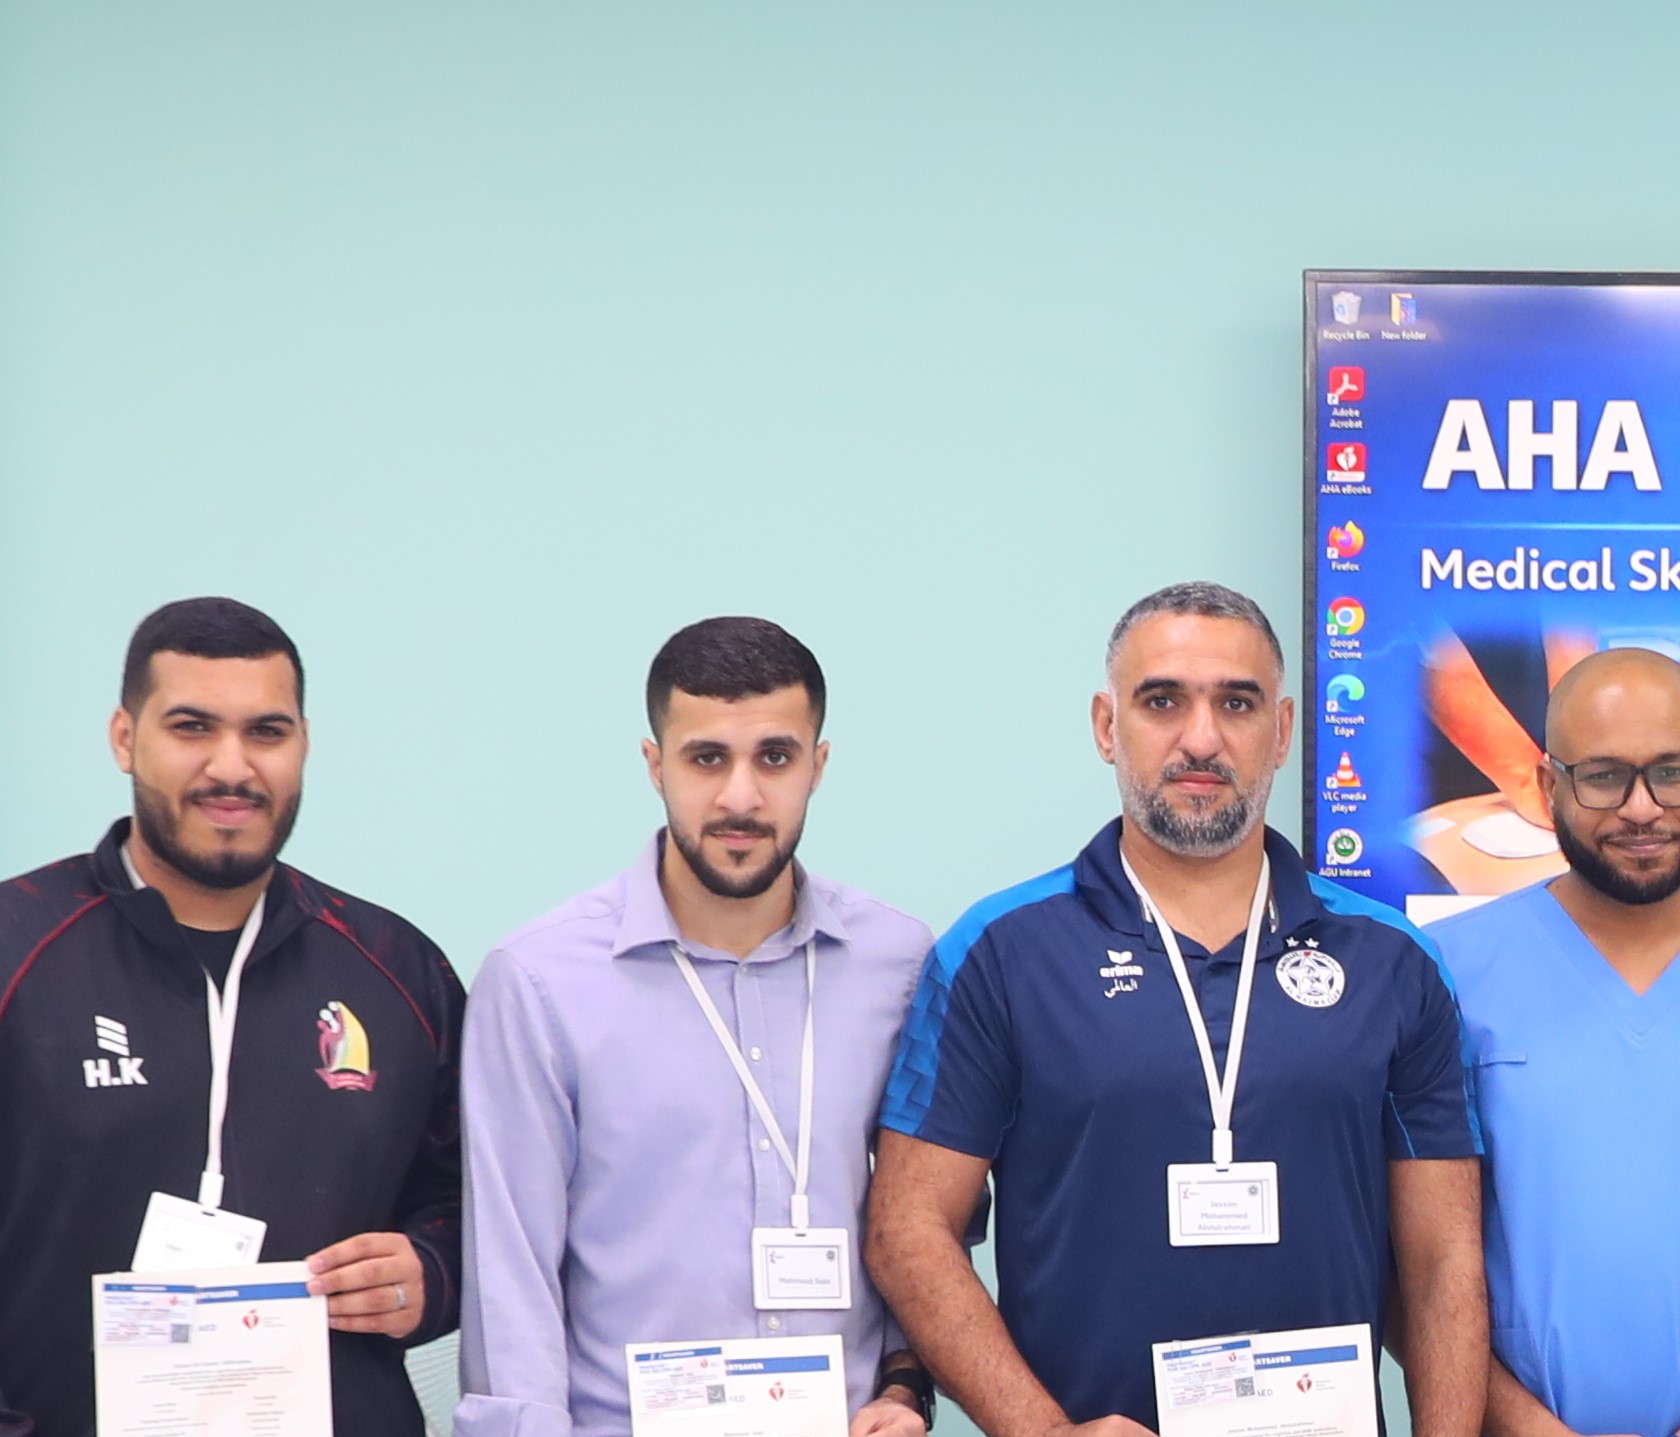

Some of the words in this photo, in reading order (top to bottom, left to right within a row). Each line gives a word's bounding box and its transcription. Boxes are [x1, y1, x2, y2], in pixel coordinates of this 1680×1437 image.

[1423, 399, 1662, 491] AHA
[1422, 546, 1615, 591] Medical
[82, 1057, 149, 1088] H.K
